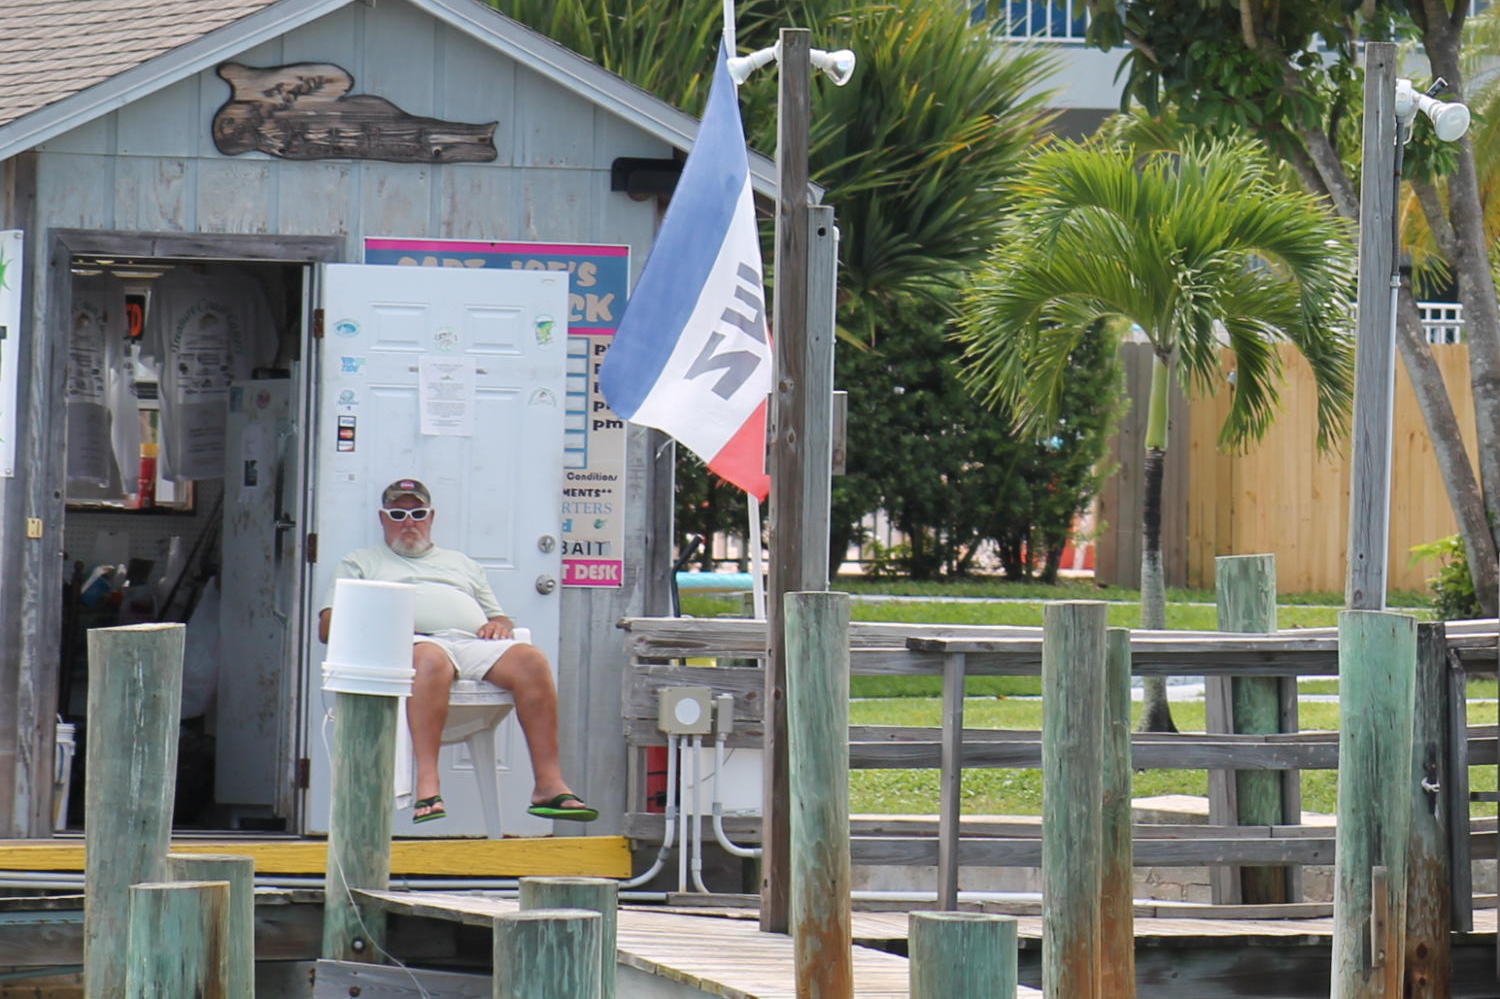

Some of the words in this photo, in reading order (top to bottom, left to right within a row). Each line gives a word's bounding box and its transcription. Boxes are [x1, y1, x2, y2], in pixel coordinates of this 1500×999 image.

[593, 419, 624, 431] pm
[566, 472, 618, 481] Conditions
[575, 564, 619, 580] DESK
